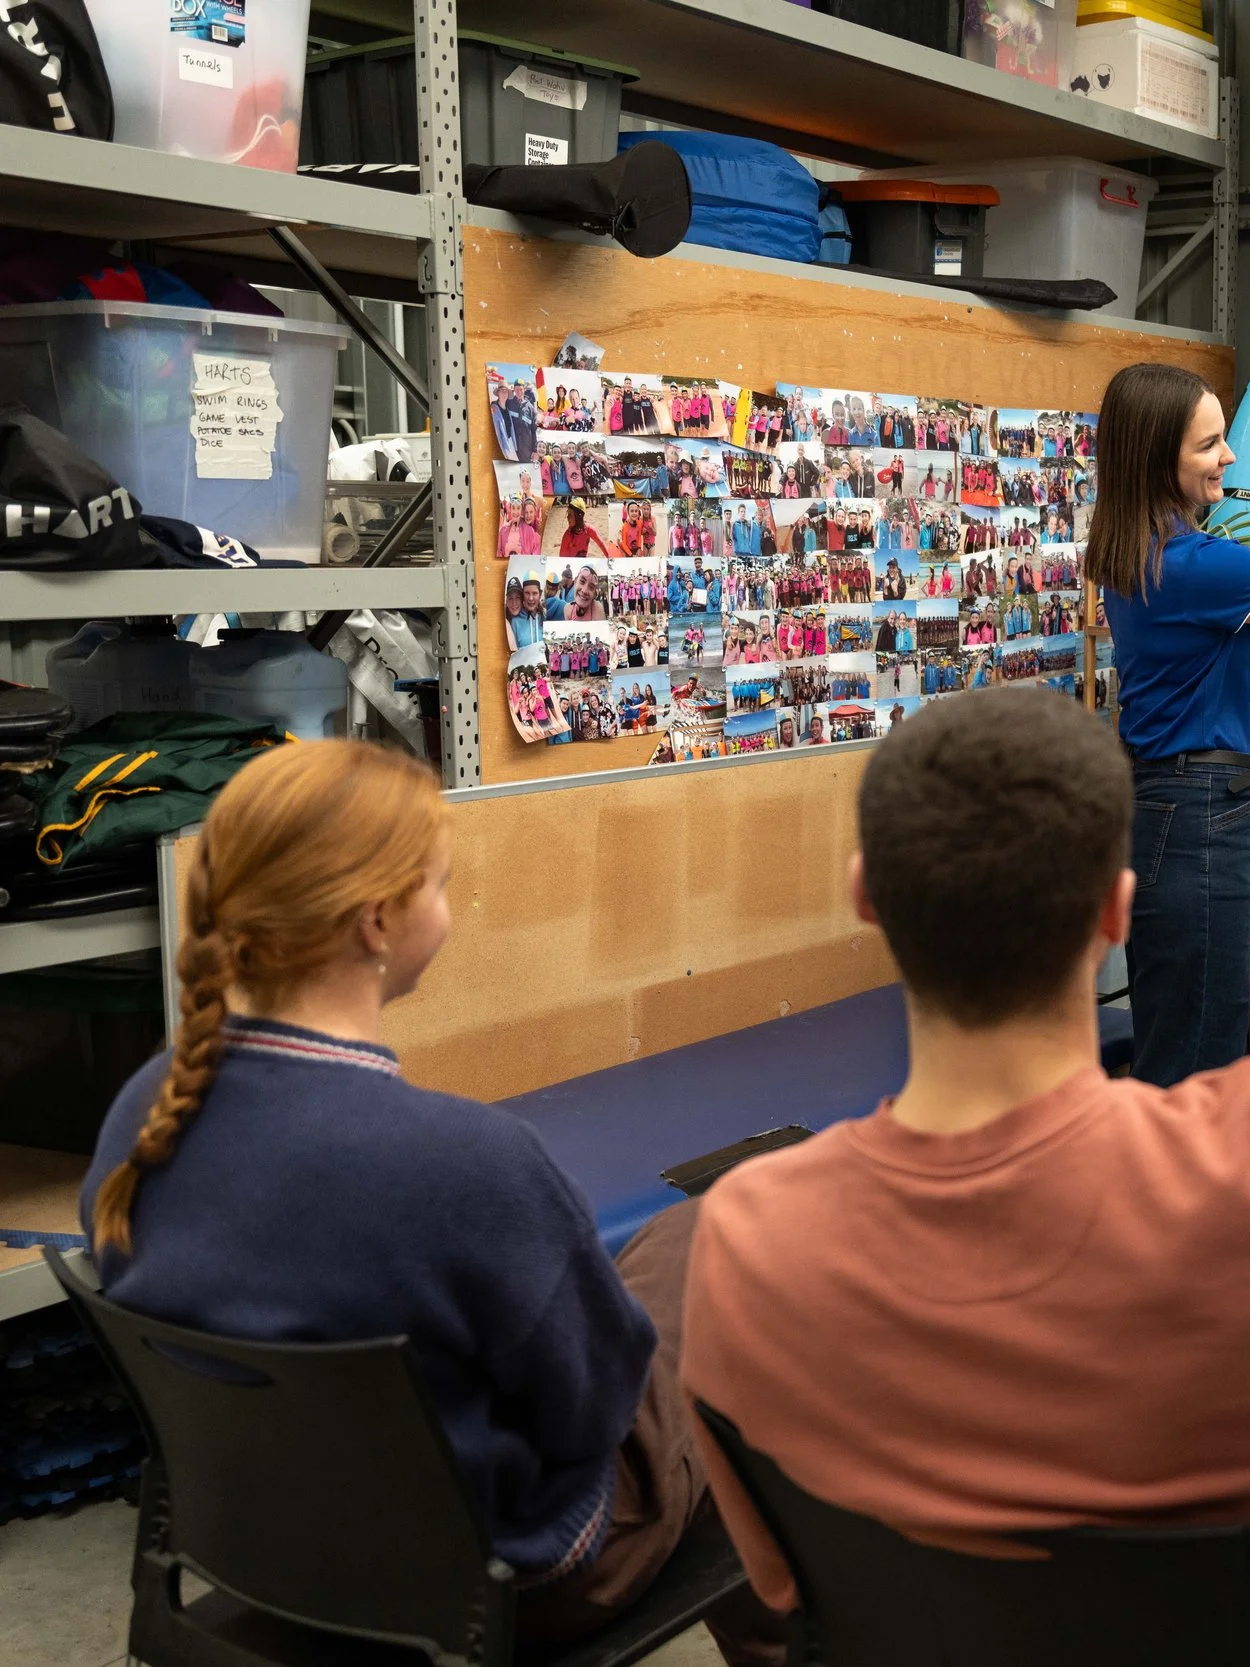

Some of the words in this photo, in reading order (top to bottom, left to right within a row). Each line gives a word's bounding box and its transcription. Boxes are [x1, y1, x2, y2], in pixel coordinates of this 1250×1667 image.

[220, 4, 242, 15] WHEELS
[182, 54, 221, 73] Tunnels
[540, 89, 559, 102] Toys
[528, 137, 545, 150] Heavy
[545, 140, 559, 152] Duty
[528, 147, 549, 161] Storage
[205, 363, 252, 386] HARTS
[196, 395, 227, 406] SWIM
[237, 396, 268, 410] RINGS
[199, 413, 225, 423] GAME
[235, 415, 258, 424] VEST
[200, 438, 223, 448] DICE
[5, 487, 134, 539] HART
